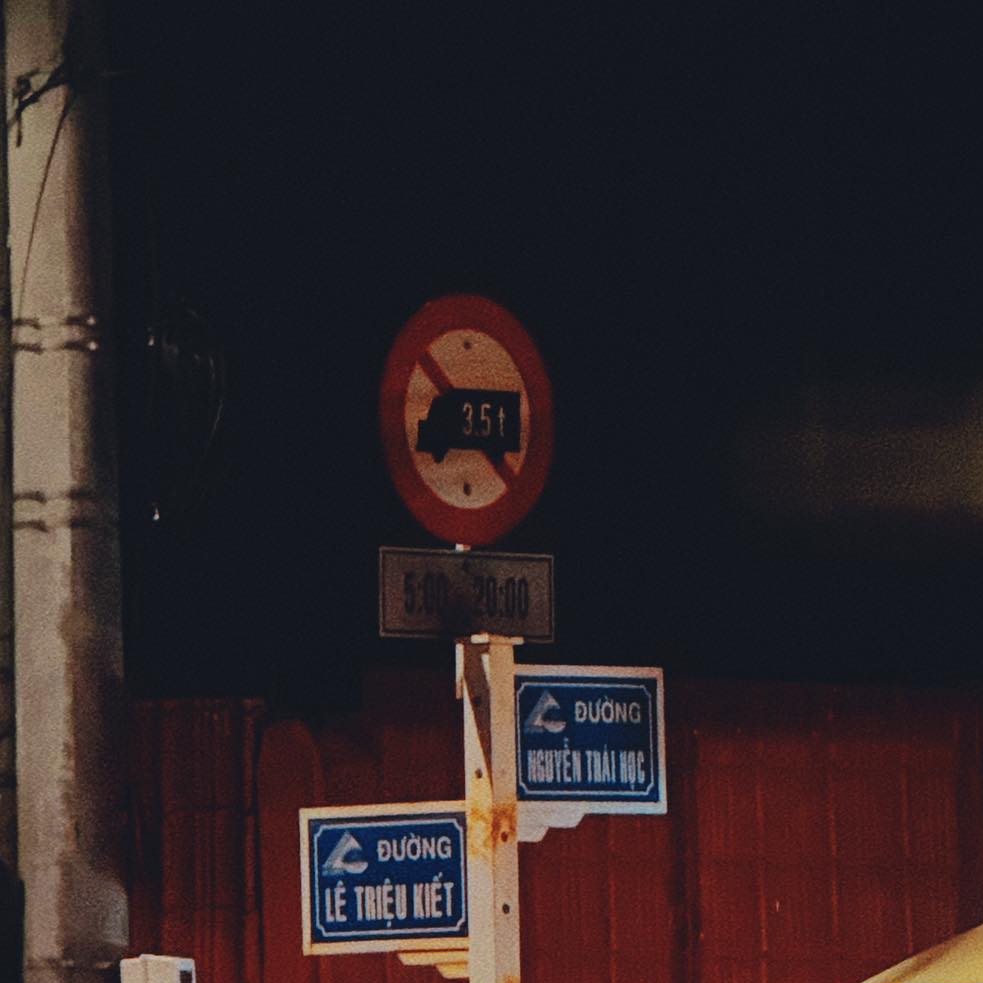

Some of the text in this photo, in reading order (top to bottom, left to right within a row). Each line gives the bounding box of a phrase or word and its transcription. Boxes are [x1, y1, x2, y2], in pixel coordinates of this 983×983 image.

[574, 695, 642, 724] ĐƯỜNG
[619, 750, 646, 791] HỌC
[377, 835, 452, 862] ĐƯỜNG
[325, 871, 454, 928] LÊ TRIỆU KIẾT
